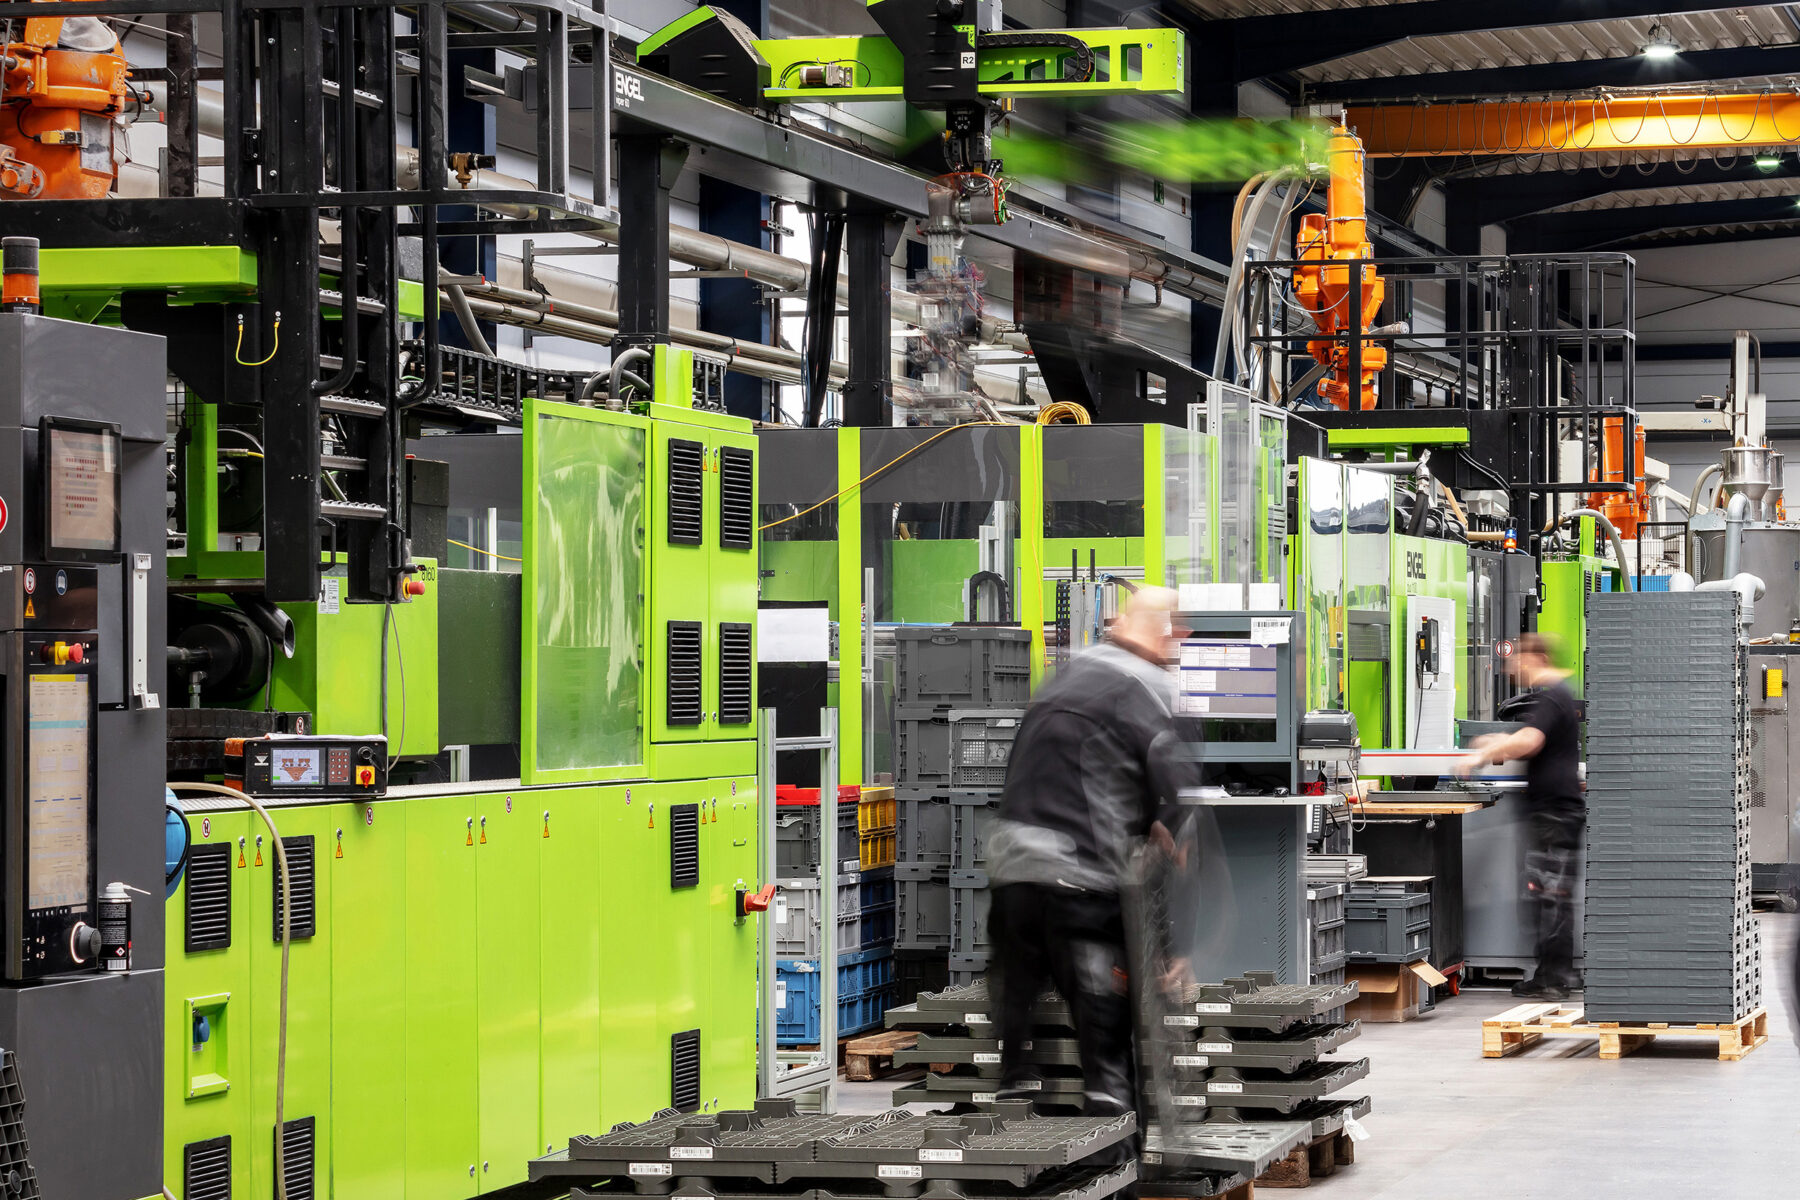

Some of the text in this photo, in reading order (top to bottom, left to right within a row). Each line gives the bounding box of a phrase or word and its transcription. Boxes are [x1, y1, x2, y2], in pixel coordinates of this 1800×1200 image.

[962, 56, 974, 64] R2
[615, 71, 645, 102] ENGEL
[1407, 550, 1427, 580] ENGEL
